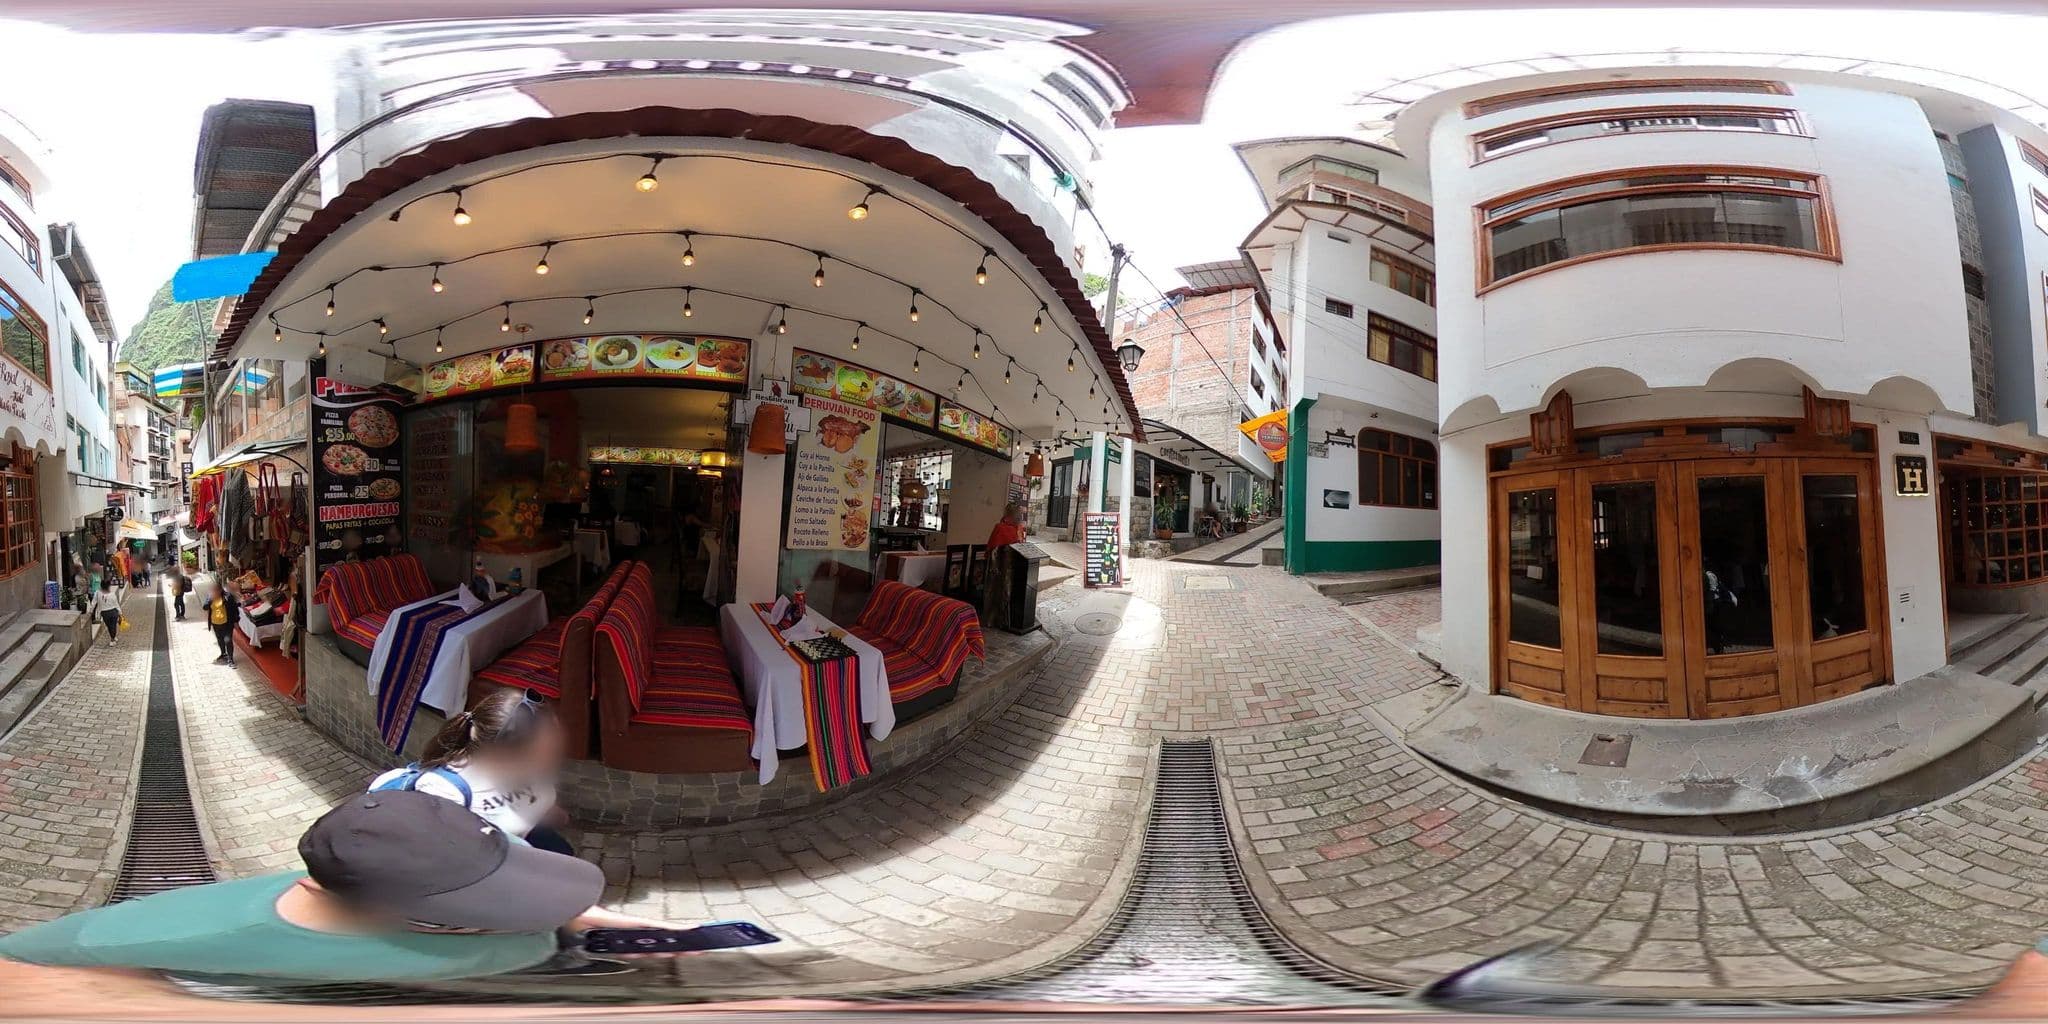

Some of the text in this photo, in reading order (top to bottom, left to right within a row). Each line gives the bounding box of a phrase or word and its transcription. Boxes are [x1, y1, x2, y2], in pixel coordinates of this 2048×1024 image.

[755, 393, 795, 405] Restaurant
[804, 397, 851, 416] PERUVIAN
[852, 408, 876, 422] FOOD
[799, 450, 809, 460] Cuy
[798, 461, 809, 471] Cuy
[1902, 467, 1924, 491] H
[797, 483, 814, 493] Alpaca
[319, 502, 400, 522] HAMBURGUESAS
[795, 517, 809, 525] Lomo
